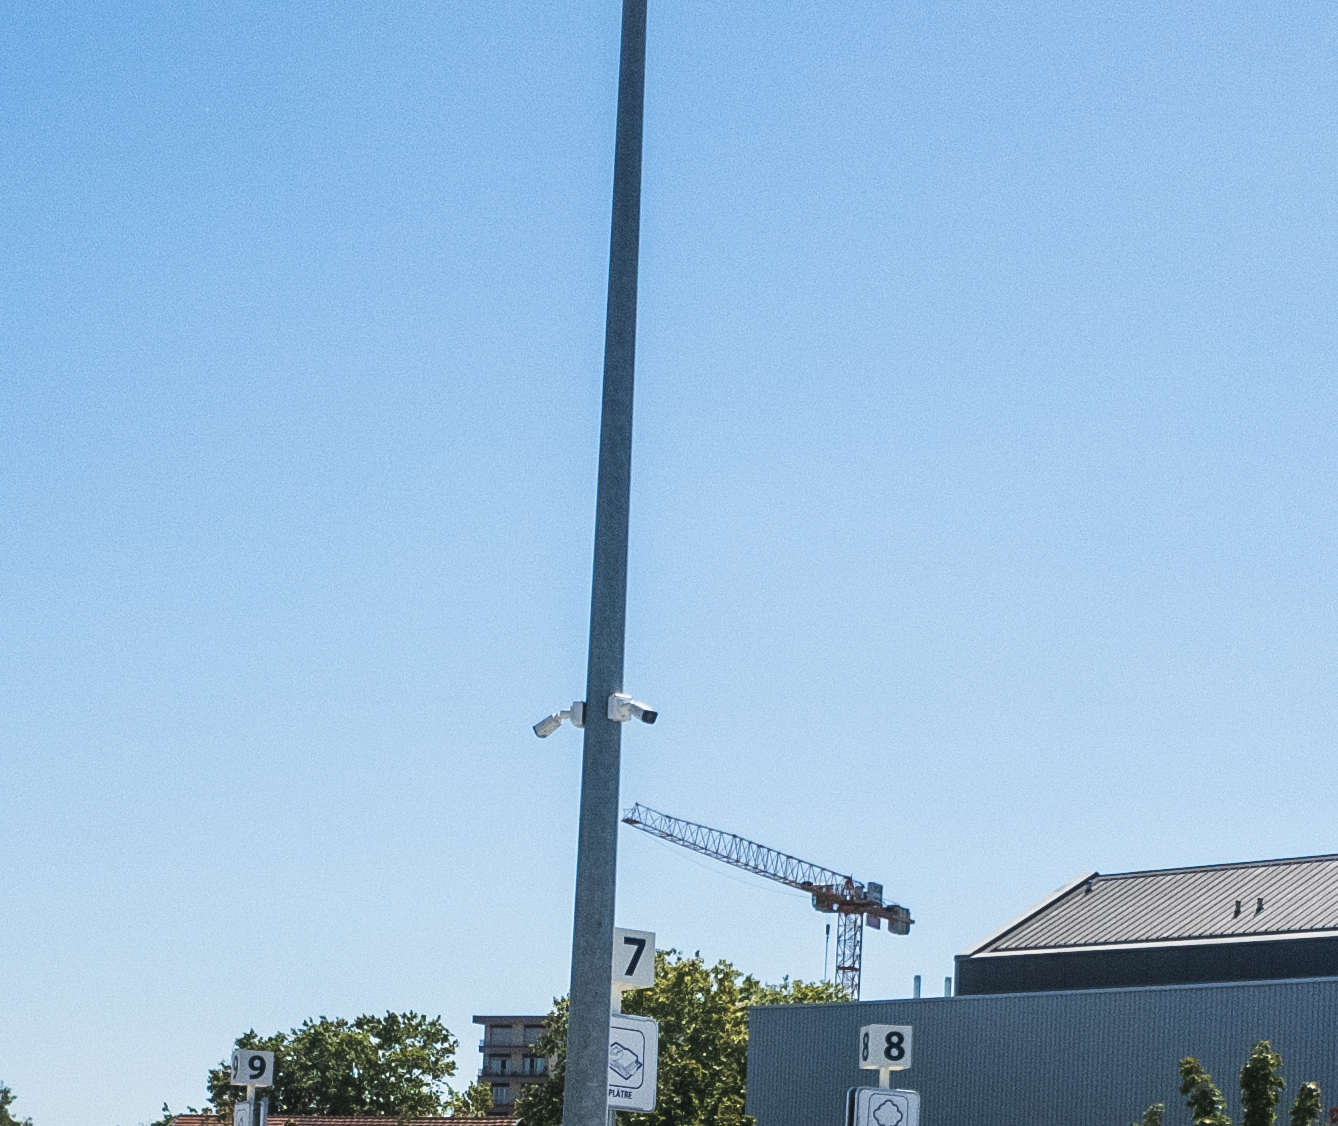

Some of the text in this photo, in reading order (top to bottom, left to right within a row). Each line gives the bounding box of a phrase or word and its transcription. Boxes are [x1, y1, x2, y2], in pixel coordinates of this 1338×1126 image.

[623, 936, 646, 976] 7
[862, 1032, 869, 1061] 8
[884, 1031, 905, 1061] 8
[248, 1055, 266, 1079] 9
